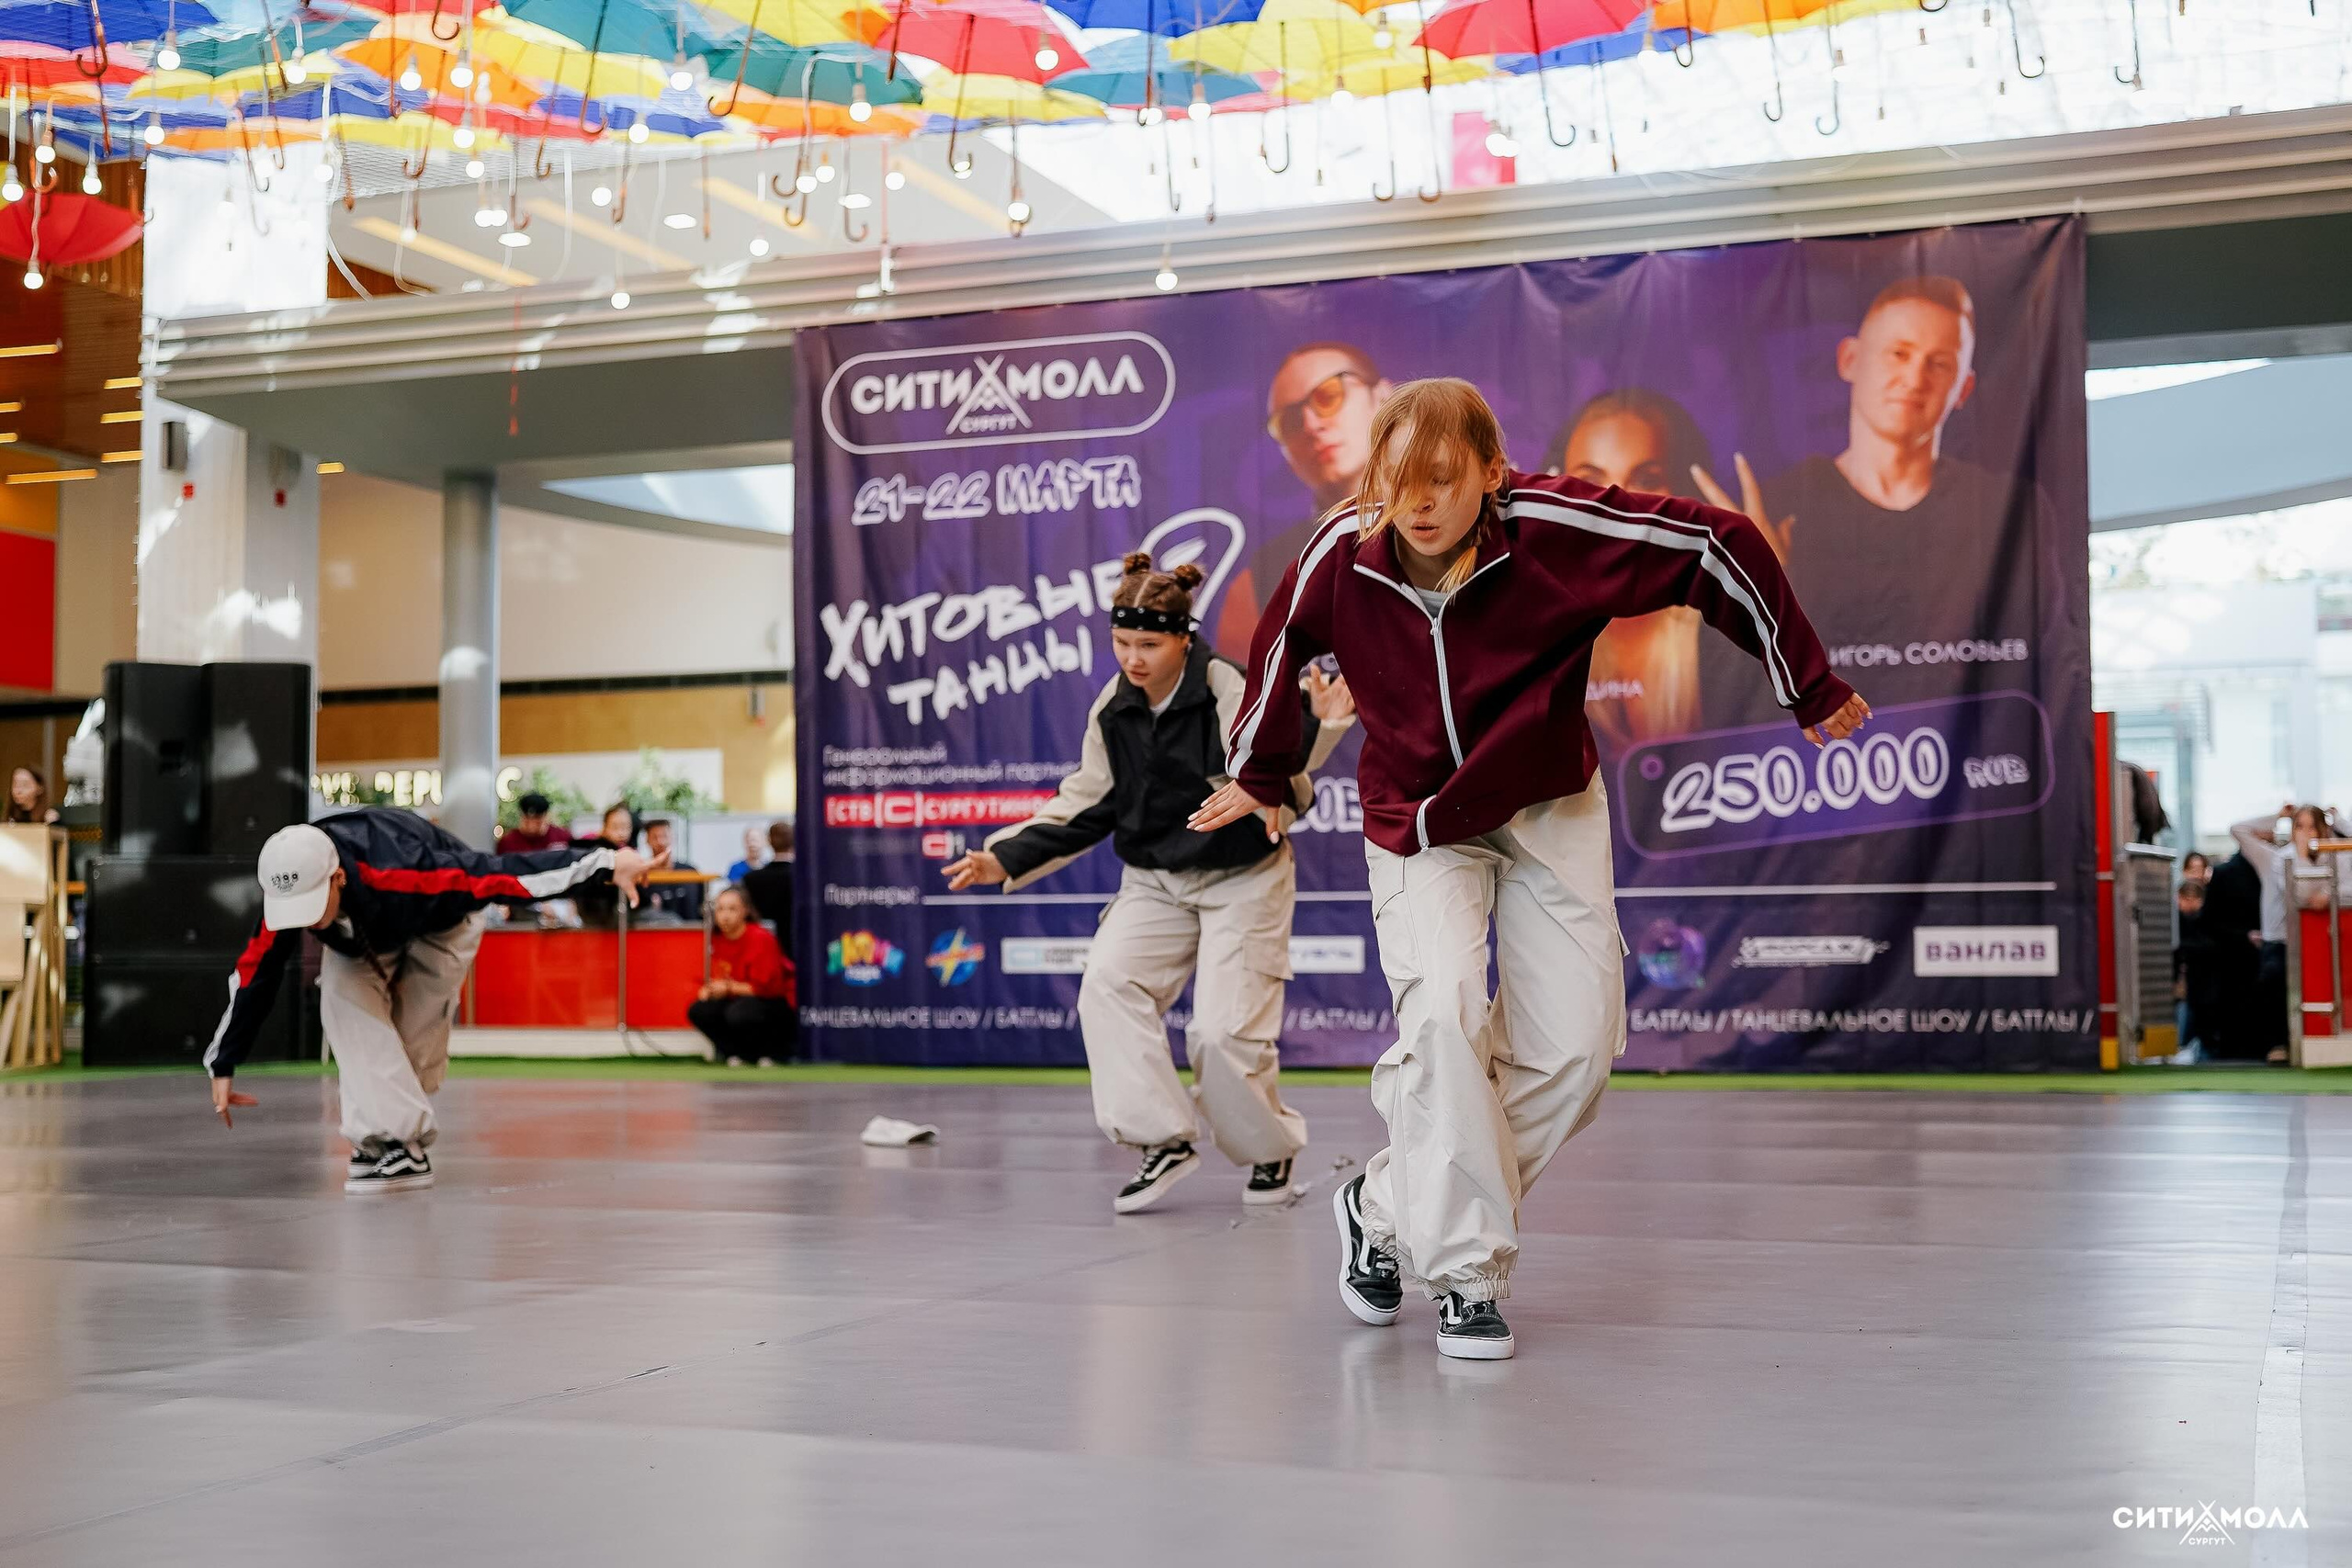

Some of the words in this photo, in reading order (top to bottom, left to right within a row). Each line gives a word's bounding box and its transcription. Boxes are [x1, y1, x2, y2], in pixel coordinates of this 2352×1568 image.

[850, 367, 973, 415] СИТИ
[1007, 354, 1146, 401] МОЛЛ
[852, 471, 992, 526] 21-22
[996, 455, 1142, 516] МАРТА
[1828, 644, 1904, 668] ИГОРЬ
[1905, 638, 2030, 665] СОЛОВЬЕВ
[887, 626, 1093, 726] ТАНЦЫ
[1660, 727, 1950, 833] 250.000
[1963, 754, 2030, 789] RUB
[1925, 940, 2047, 963] ванлав
[933, 1005, 979, 1030] ШОУ
[1731, 1008, 1908, 1033] ТАНЦЕВАЛЬНОЕ
[1910, 1008, 1973, 1033] ШОУ
